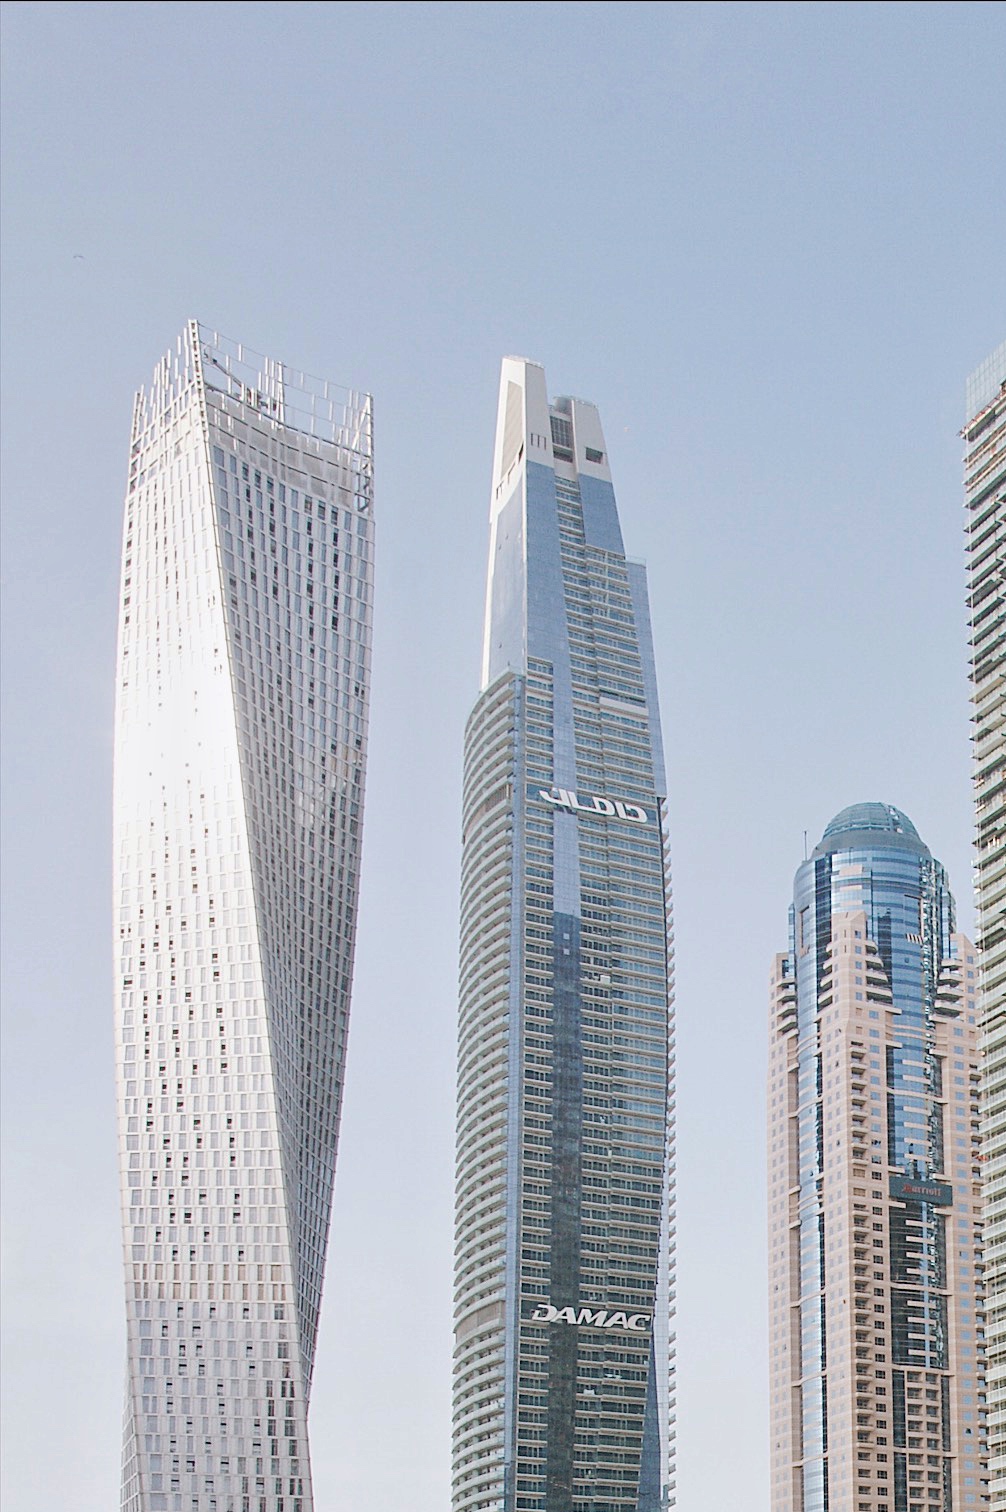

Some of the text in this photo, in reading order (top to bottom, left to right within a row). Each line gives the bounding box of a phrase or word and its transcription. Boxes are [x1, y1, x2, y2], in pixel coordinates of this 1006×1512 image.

[539, 787, 648, 824] داماك
[901, 1183, 941, 1197] Marriott
[531, 1303, 651, 1331] DAMAC
